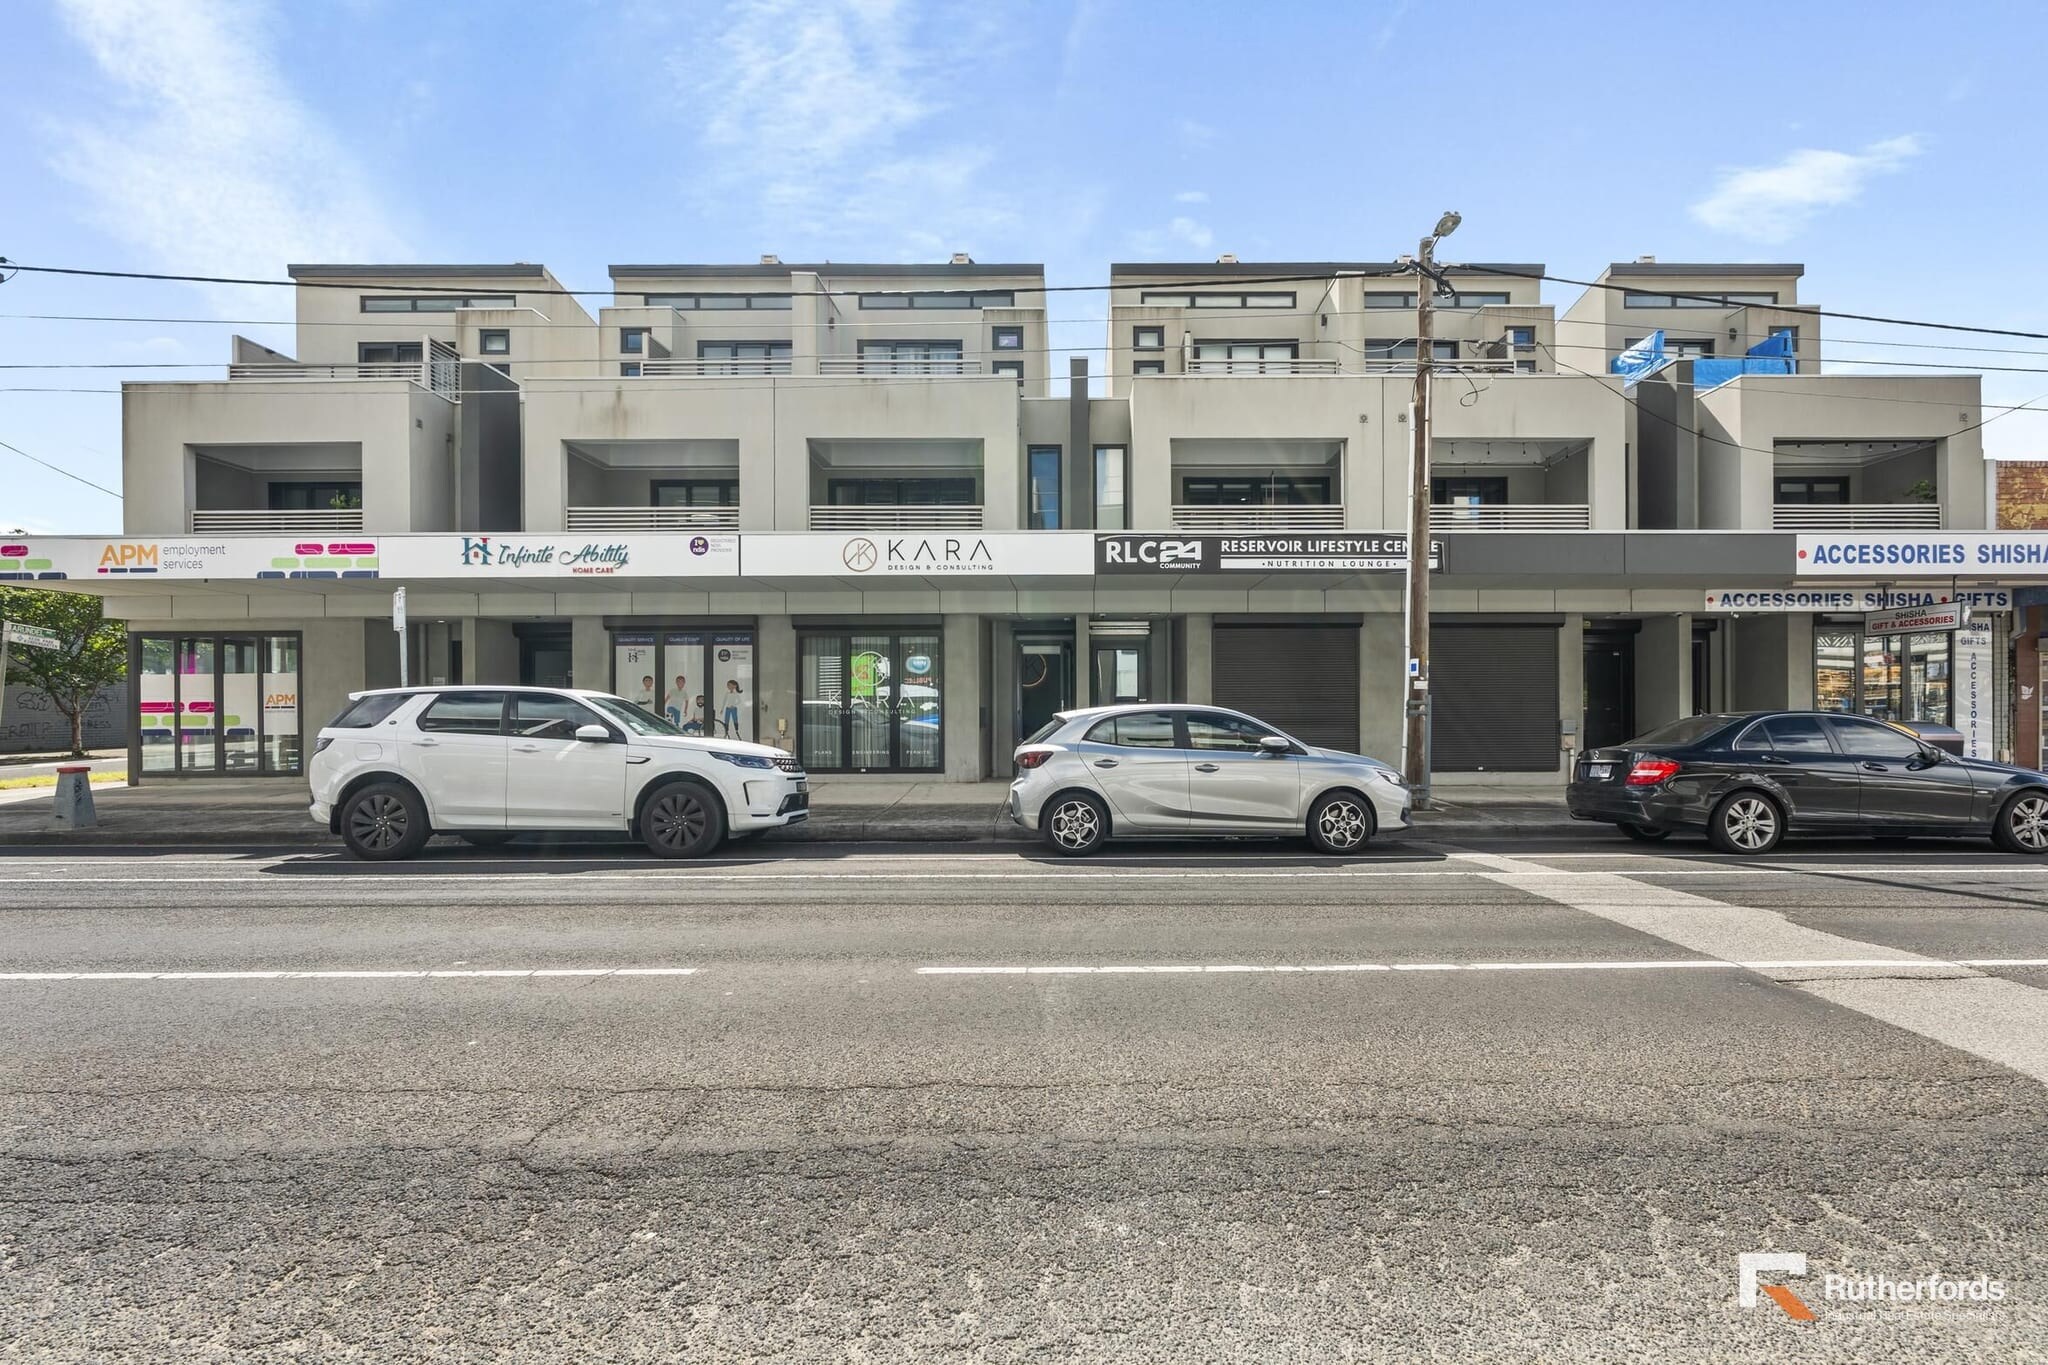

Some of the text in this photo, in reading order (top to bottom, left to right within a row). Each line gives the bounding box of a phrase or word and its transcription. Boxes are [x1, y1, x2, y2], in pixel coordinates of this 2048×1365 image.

[163, 544, 226, 557] employment
[888, 539, 992, 561] KARA
[1221, 540, 1438, 552] RESERVOIR LIFESTYLE CENE
[100, 545, 158, 565] APM
[498, 544, 629, 568] Infinite Ability
[1814, 544, 1965, 564] ACCESSORIES
[163, 560, 203, 569] services
[1720, 593, 1853, 607] ACCESSORIES
[1864, 593, 1934, 607] SHISHA
[1895, 609, 1927, 619] SHISHA
[1872, 622, 1889, 631] GIFT
[1898, 615, 1954, 628] ACCESSORIES
[1960, 637, 1987, 645] GIFTS
[266, 694, 295, 705] APM
[828, 689, 915, 708] KARA
